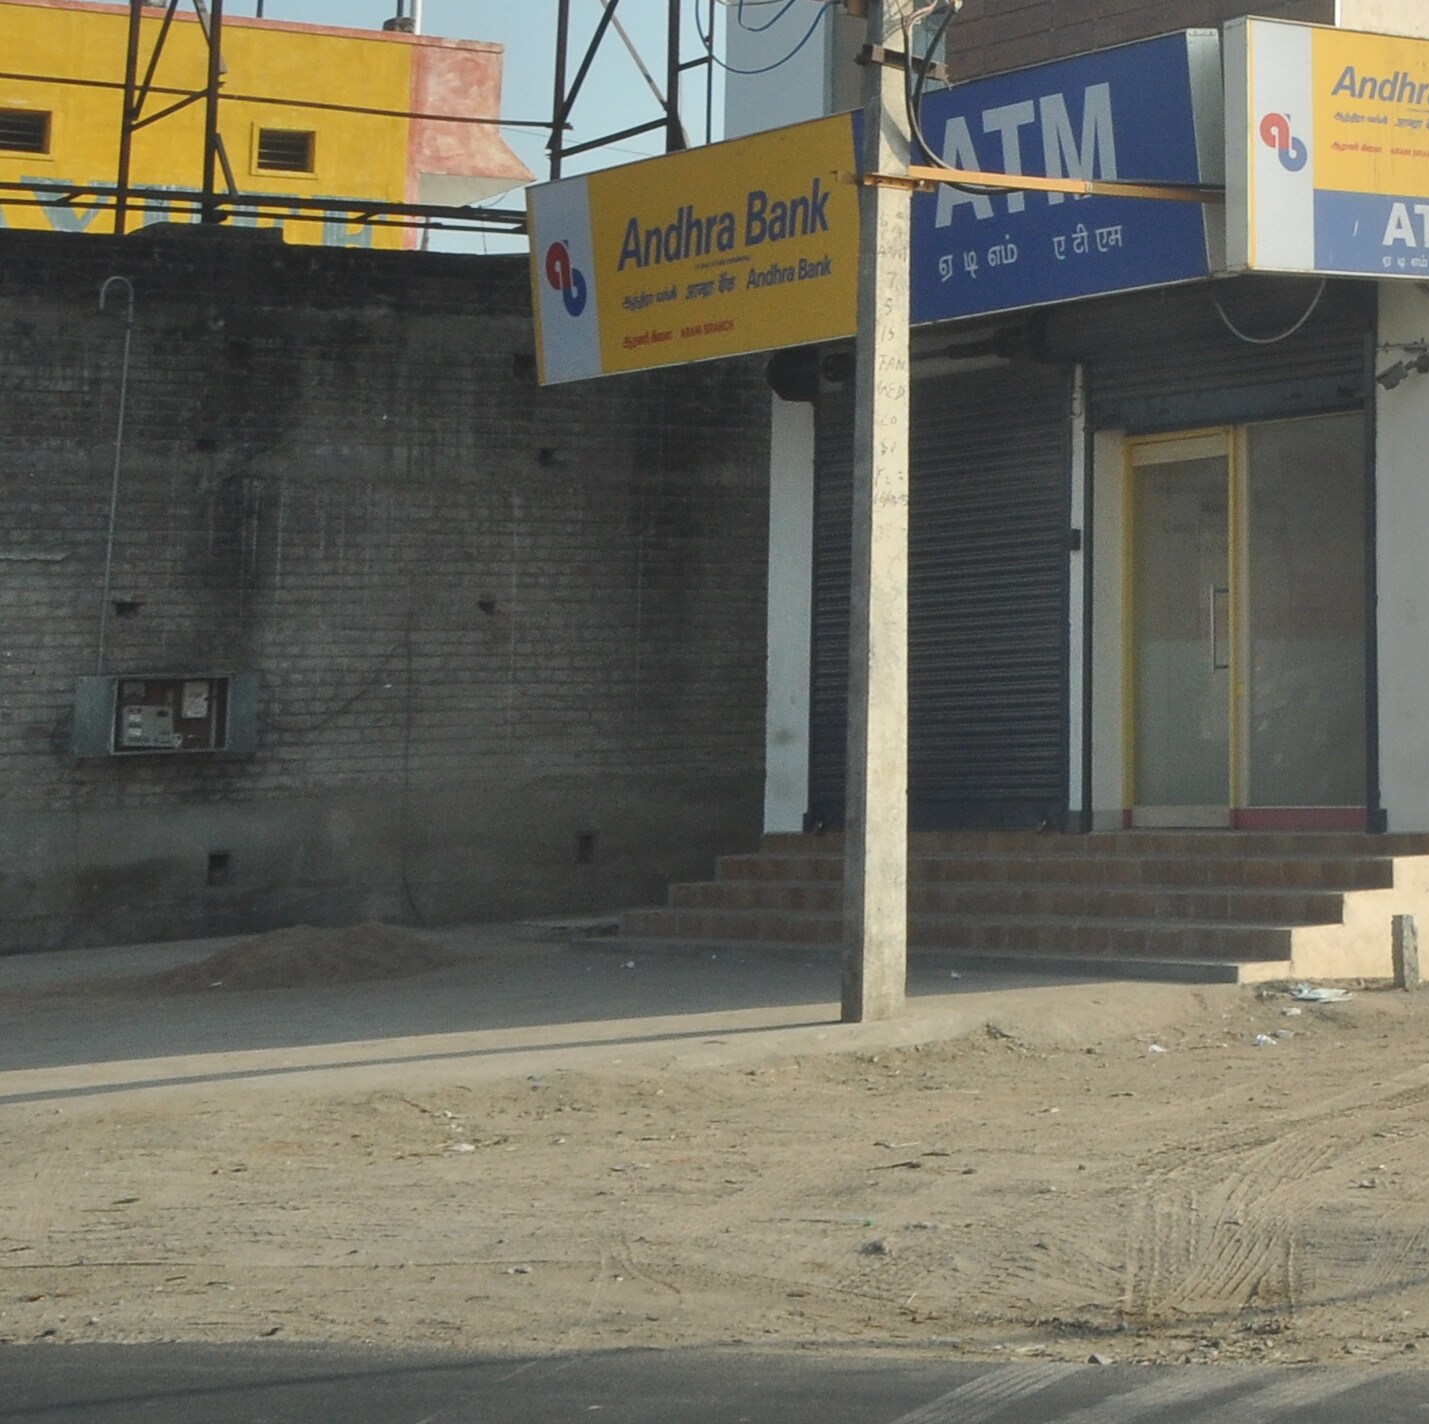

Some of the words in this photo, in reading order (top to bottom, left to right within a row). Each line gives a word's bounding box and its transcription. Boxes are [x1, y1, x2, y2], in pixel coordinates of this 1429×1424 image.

[935, 82, 1118, 229] ATM
[617, 204, 736, 271] Andhra
[744, 177, 831, 246] Bank
[1052, 236, 1066, 260] ए
[1071, 223, 1089, 254] टी
[1095, 225, 1122, 252] एम
[746, 263, 795, 289] Andhra
[798, 255, 832, 280] Bank
[938, 254, 953, 282] ஏ
[987, 233, 1018, 267] எம்
